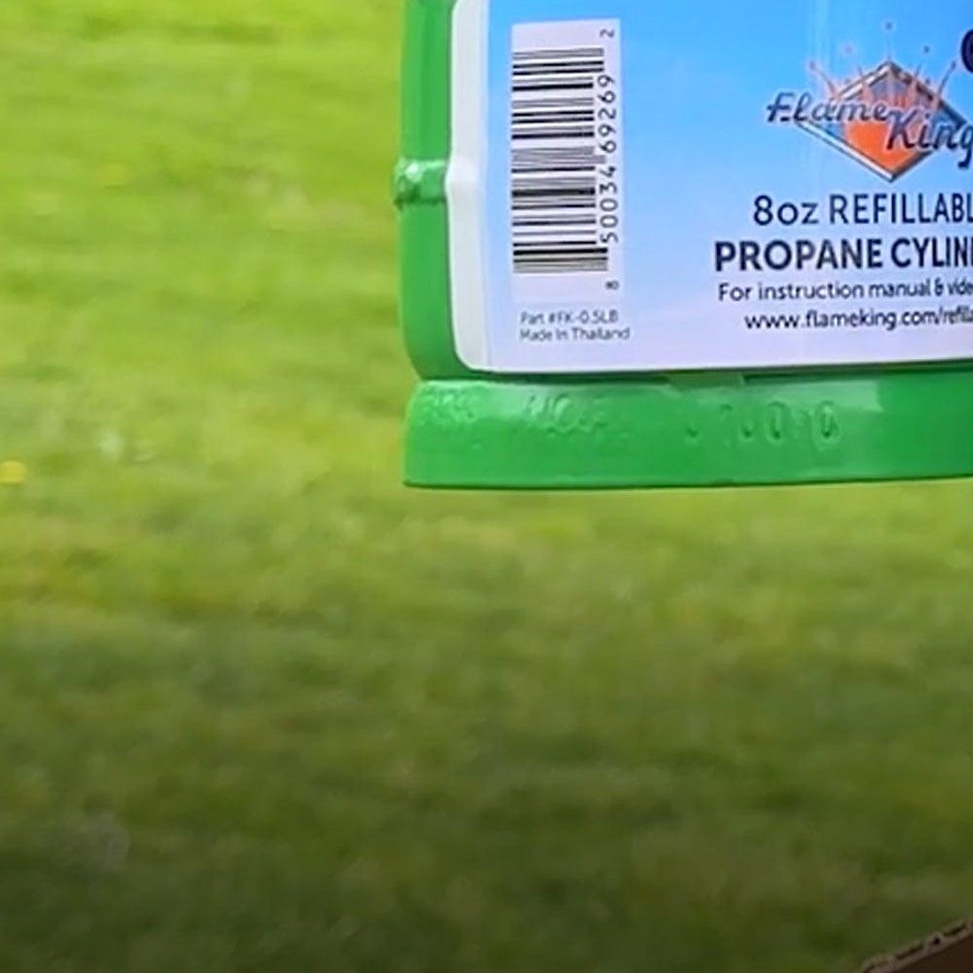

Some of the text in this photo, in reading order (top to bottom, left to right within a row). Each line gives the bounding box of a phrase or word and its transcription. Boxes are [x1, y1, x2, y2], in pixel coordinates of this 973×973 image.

[600, 28, 614, 39] 2
[598, 75, 616, 154] 69269
[766, 92, 890, 124] Flame
[600, 165, 619, 245] 50034
[753, 194, 819, 226] 8oz
[714, 238, 883, 272] PROPANE
[718, 282, 751, 302] For
[758, 279, 865, 301] instruction
[868, 277, 931, 298] manual
[519, 328, 552, 341] Made
[571, 326, 631, 340] Thailand
[520, 311, 544, 325] Part
